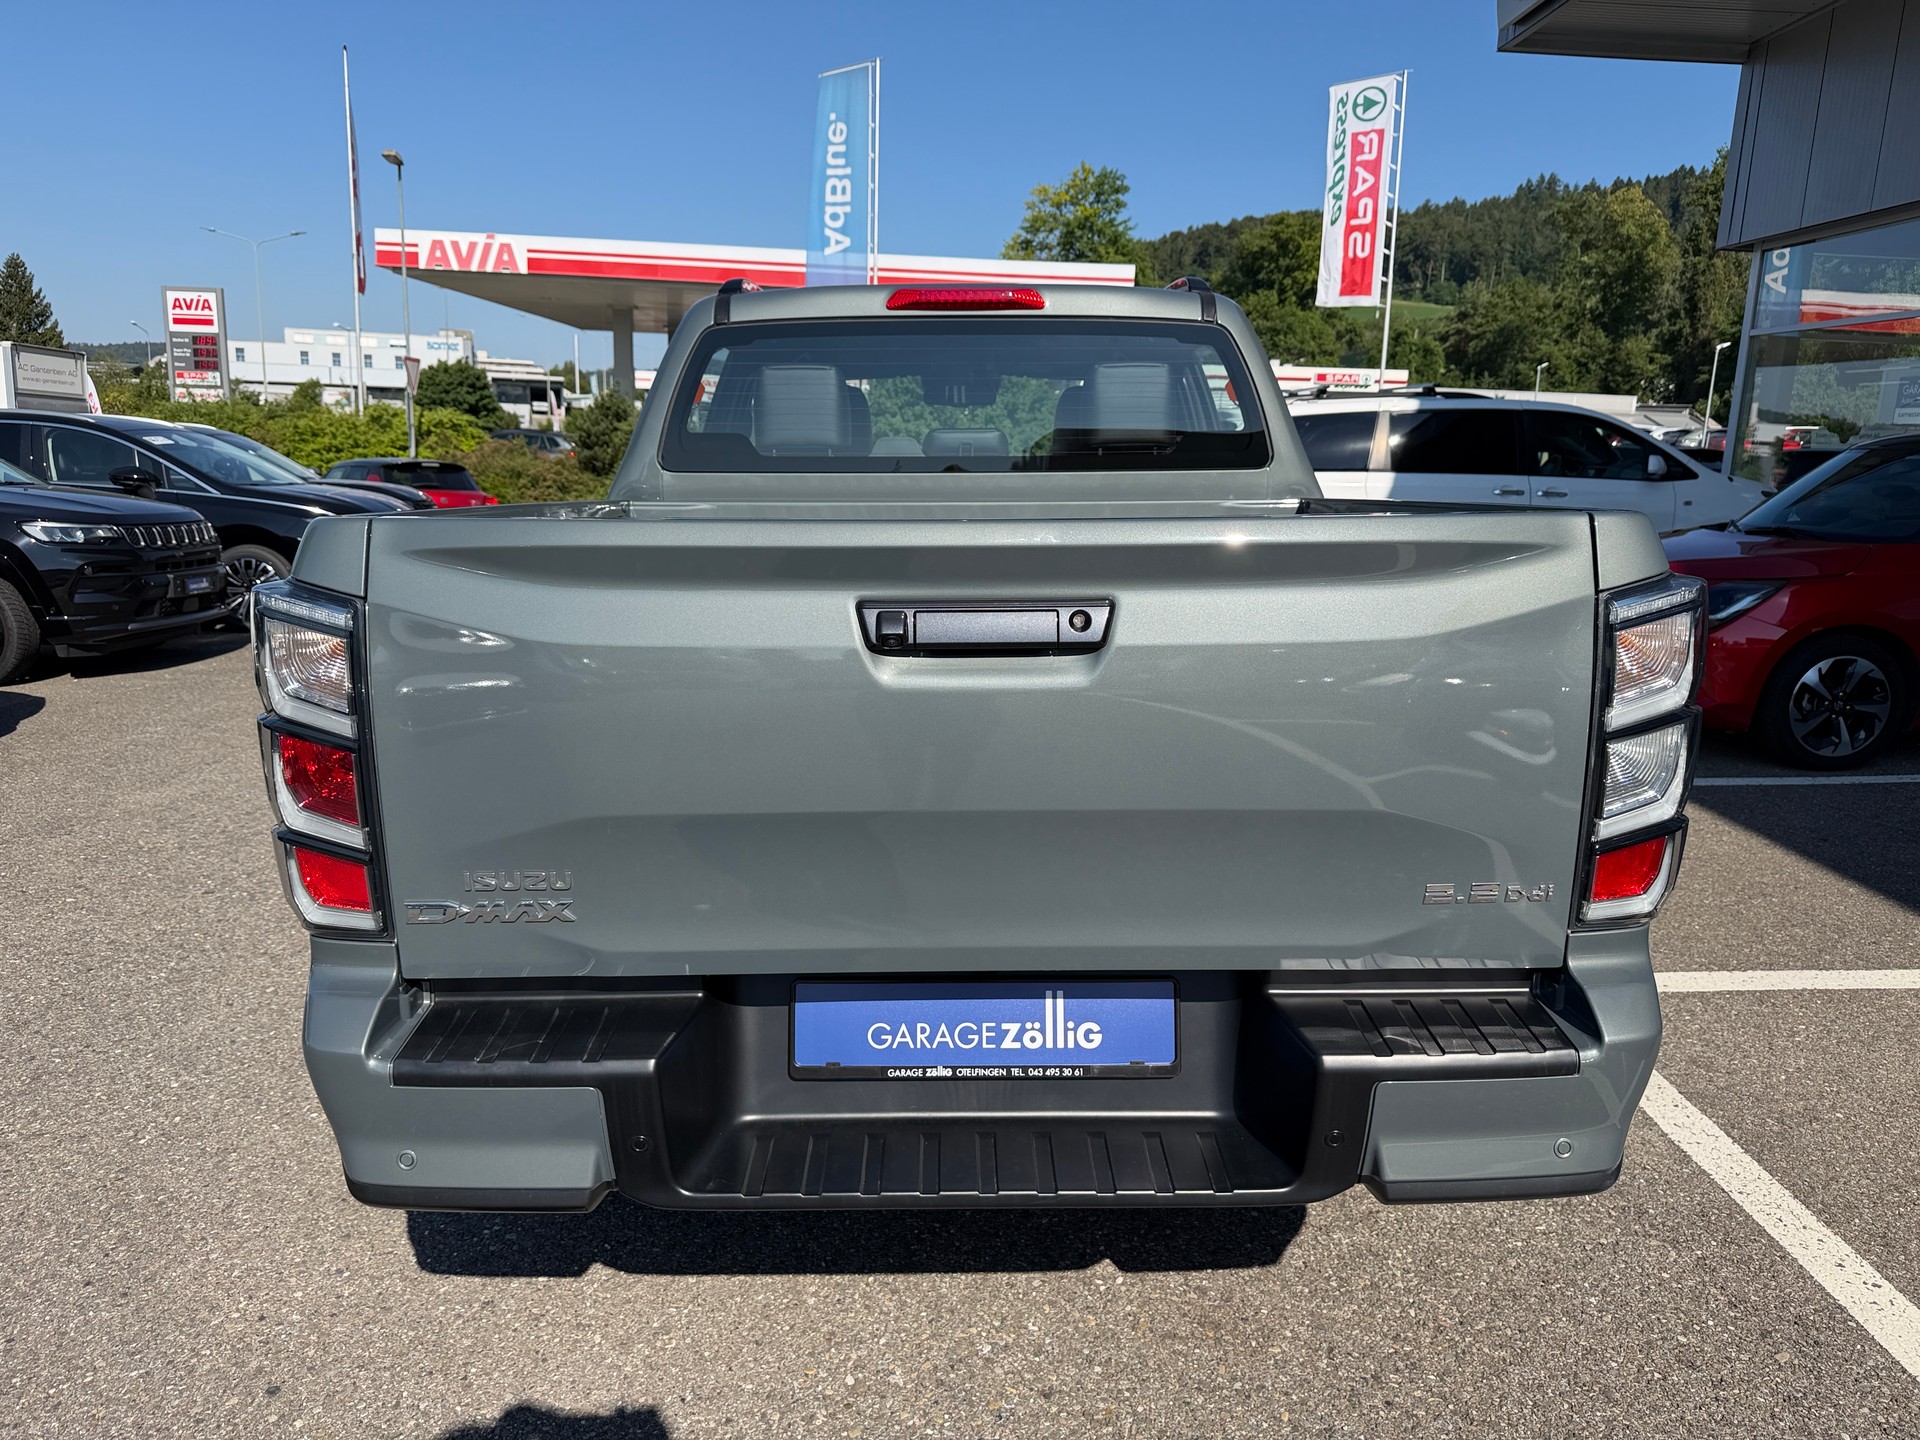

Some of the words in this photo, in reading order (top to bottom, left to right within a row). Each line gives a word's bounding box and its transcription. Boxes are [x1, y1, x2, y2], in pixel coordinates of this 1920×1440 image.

[424, 233, 521, 272] AVIA
[171, 295, 213, 312] AVIA
[1326, 373, 1360, 384] SPAR
[463, 870, 574, 892] ISUZU
[403, 900, 577, 925] D-MAX
[866, 1022, 997, 1050] GARAGE
[887, 1068, 924, 1077] GARAGE
[956, 1068, 1007, 1077] OTELFINGEN
[1028, 1067, 1044, 1076] 043
[1045, 1067, 1060, 1076] 495
[1062, 1067, 1072, 1076] 30
[1074, 1067, 1084, 1076] 61
